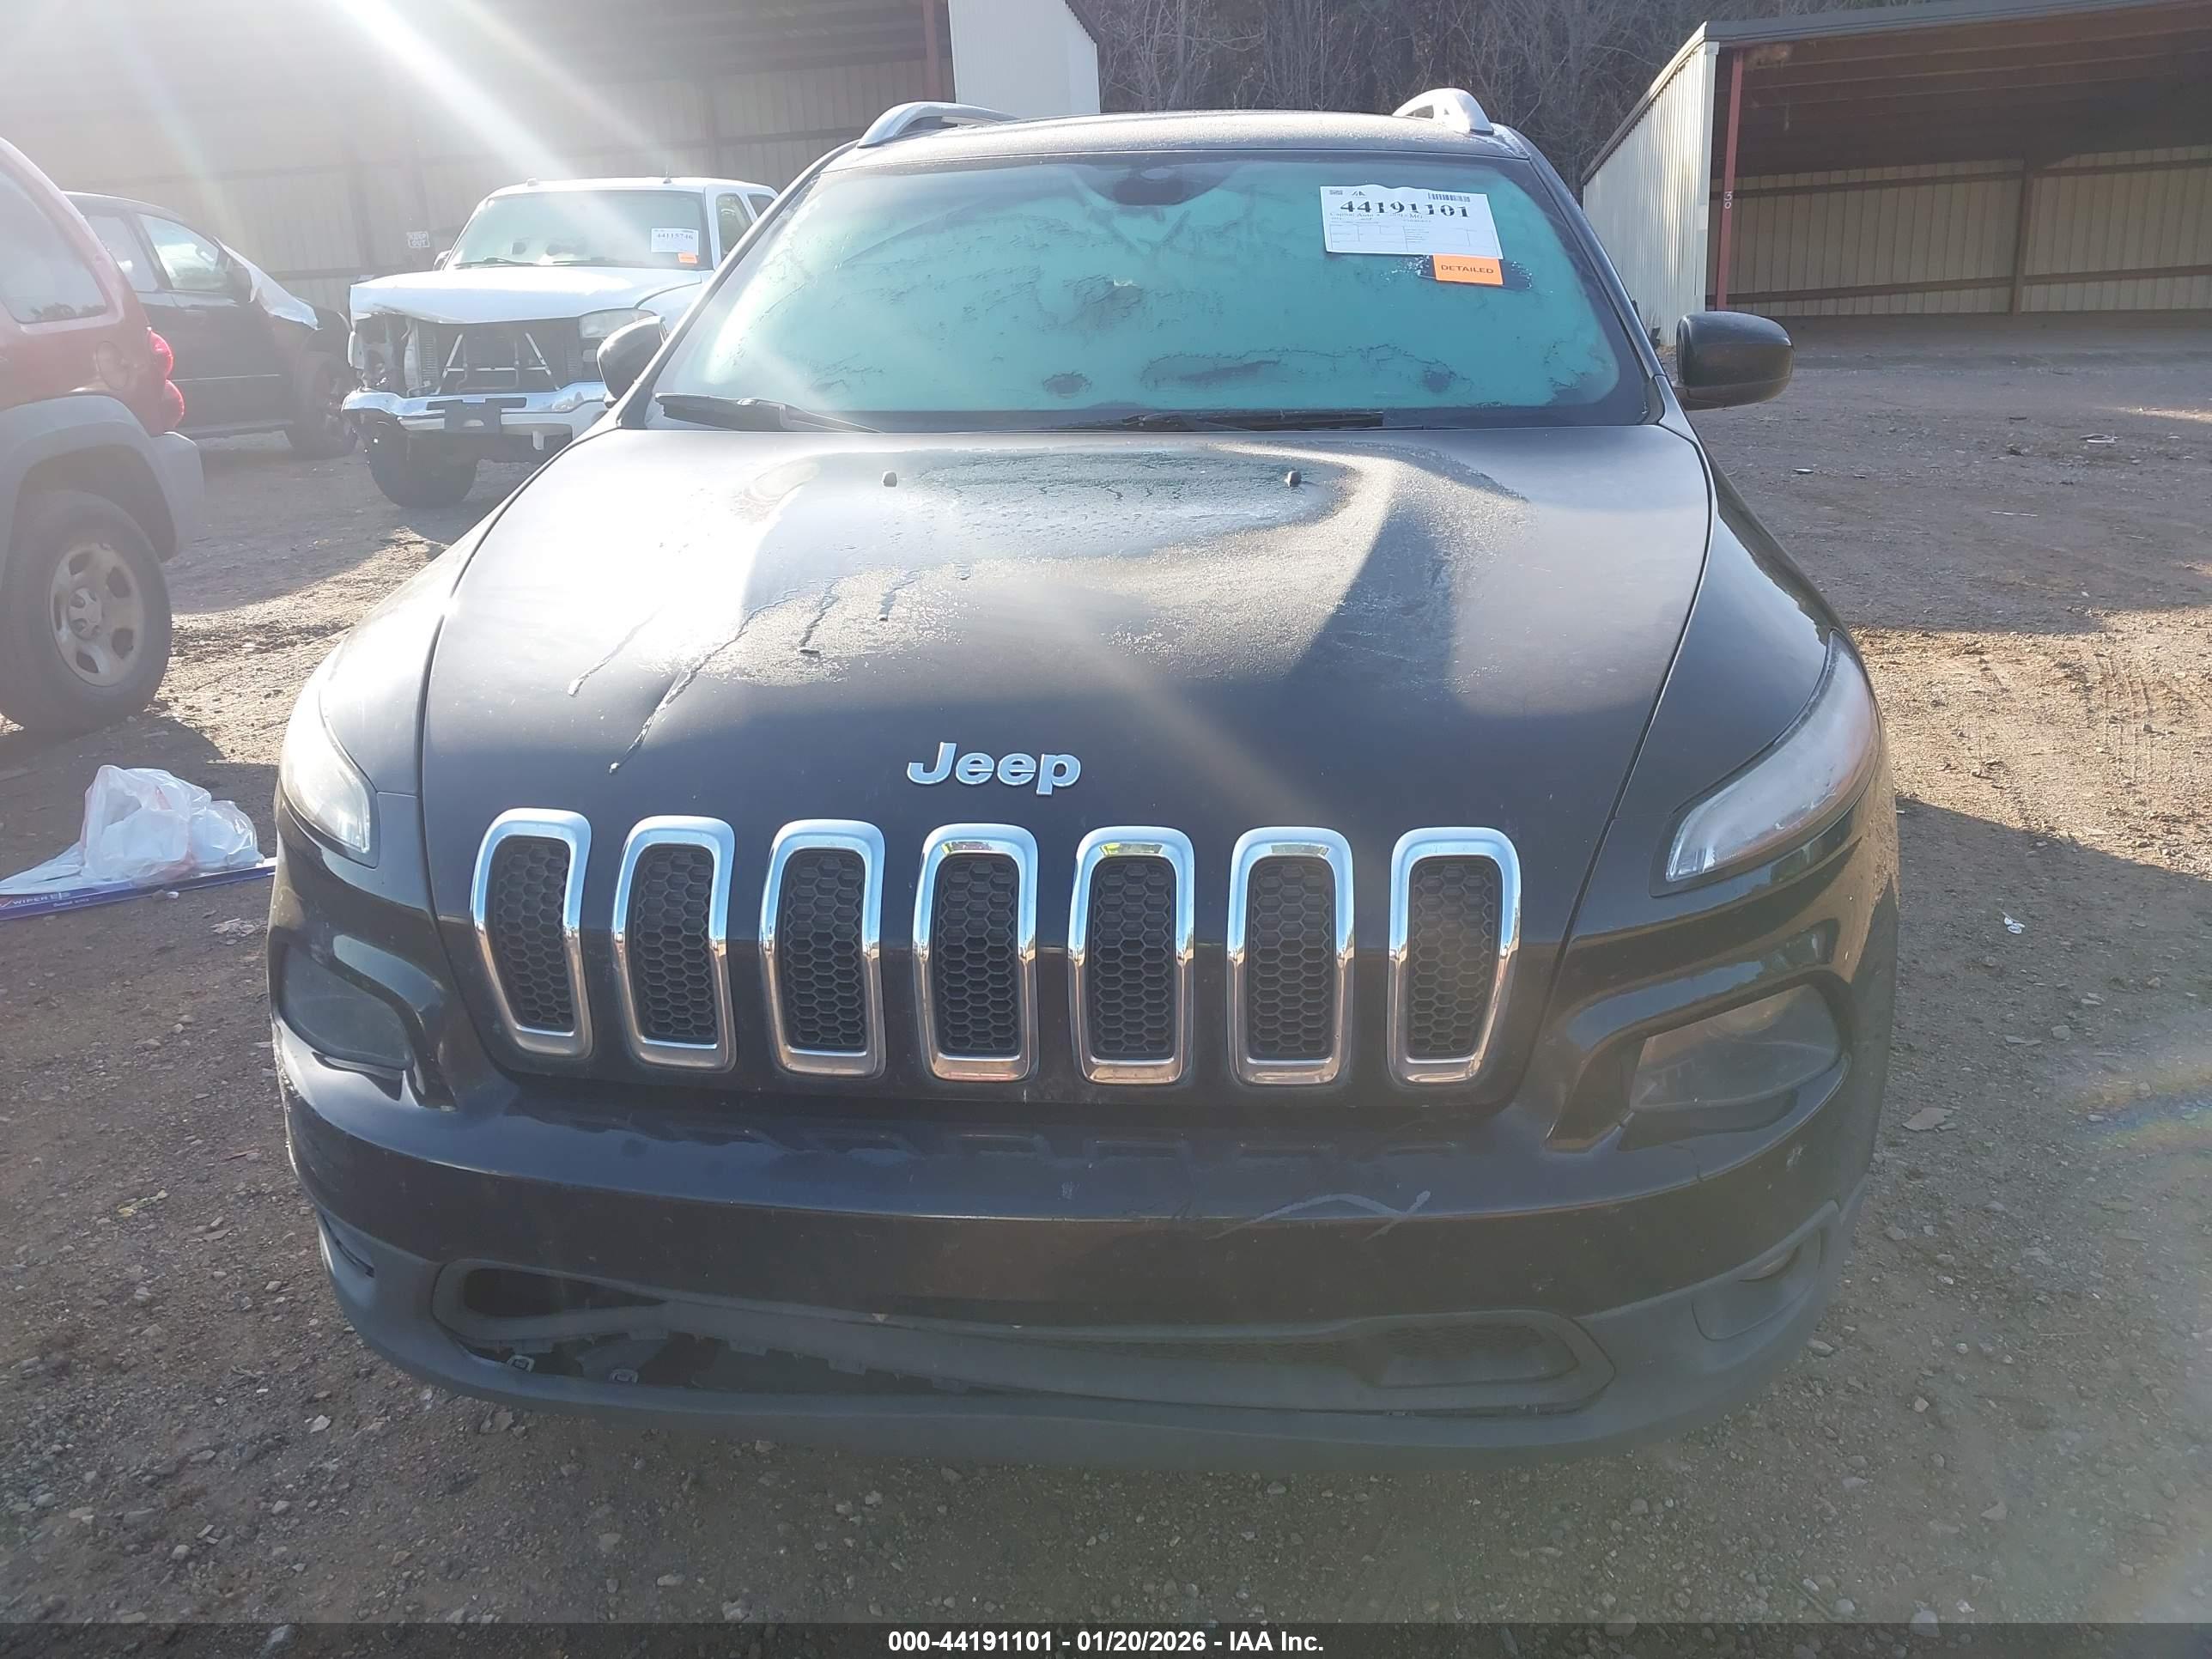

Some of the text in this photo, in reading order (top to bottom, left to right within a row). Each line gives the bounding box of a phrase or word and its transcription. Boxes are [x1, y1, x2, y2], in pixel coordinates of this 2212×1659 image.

[1340, 200, 1471, 218] 44191101
[1441, 264, 1494, 274] DETAILED
[907, 741, 1081, 795] Jeep
